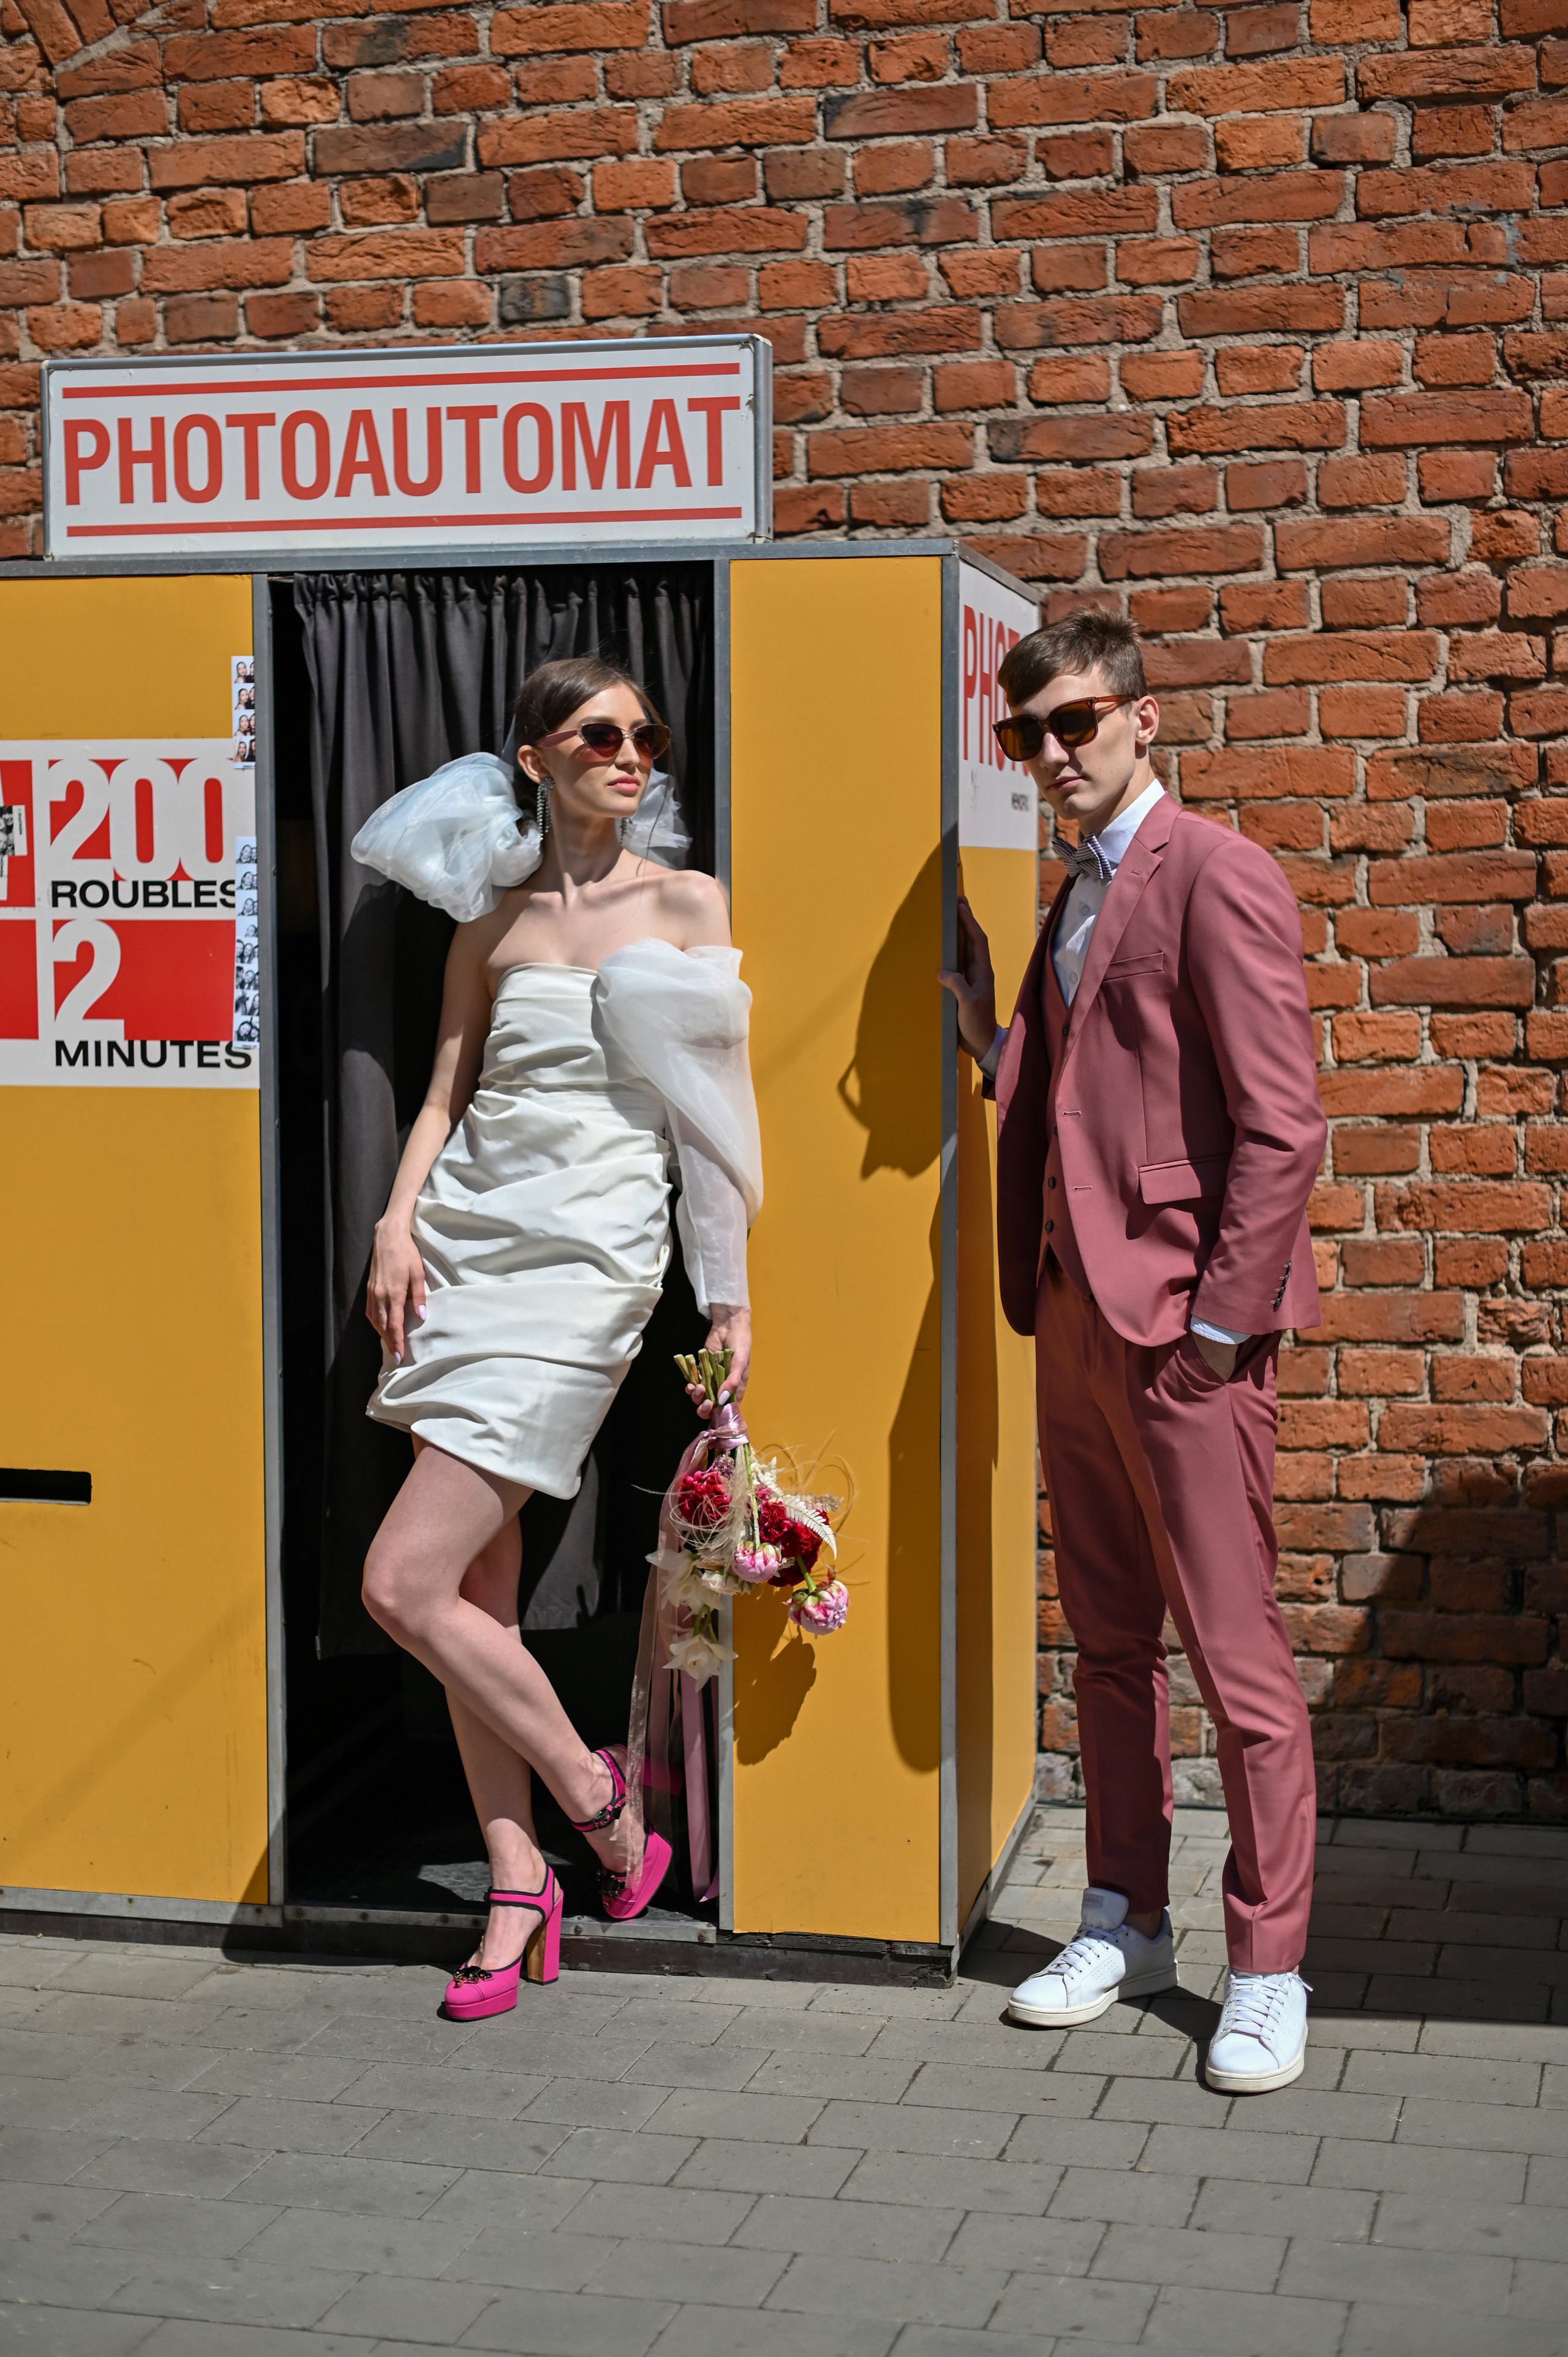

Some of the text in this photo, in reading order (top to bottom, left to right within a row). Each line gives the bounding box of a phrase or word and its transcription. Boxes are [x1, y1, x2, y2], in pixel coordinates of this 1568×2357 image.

[63, 395, 741, 505] PHOTOAUTOMAT
[48, 757, 246, 881] 200
[51, 879, 236, 909] ROUBLES
[53, 919, 124, 1040] 2
[55, 1039, 252, 1069] MINUTES
